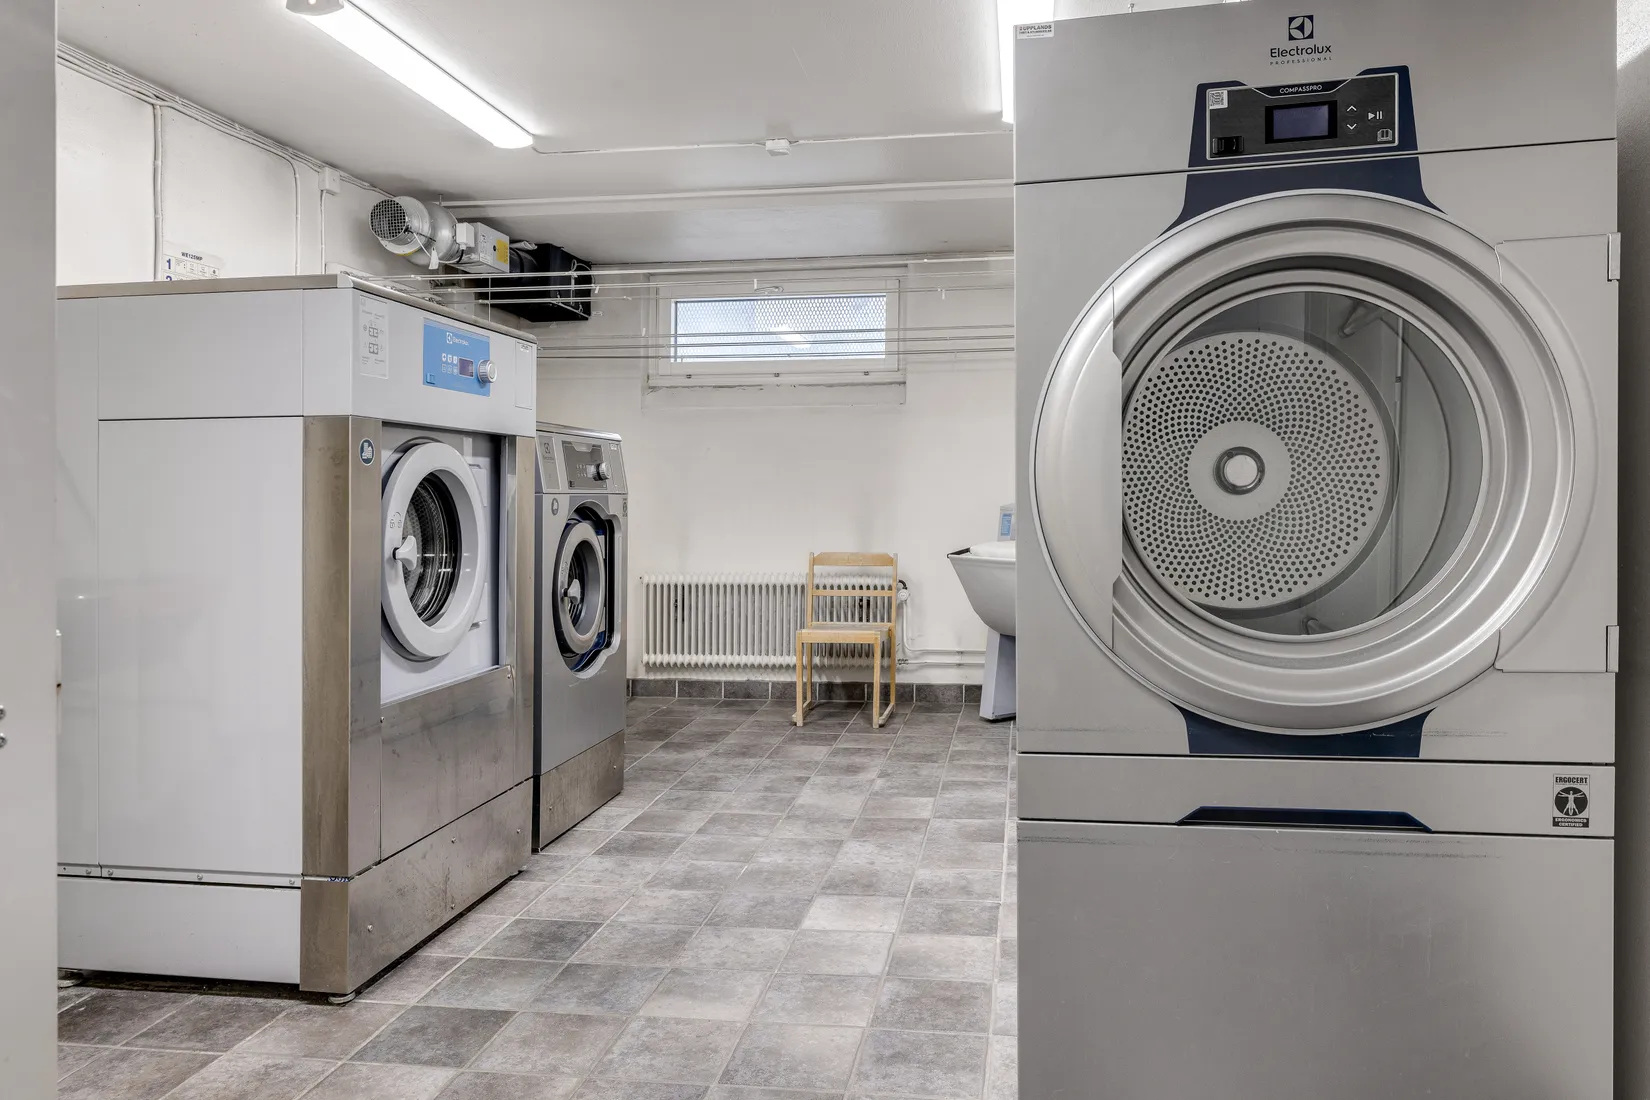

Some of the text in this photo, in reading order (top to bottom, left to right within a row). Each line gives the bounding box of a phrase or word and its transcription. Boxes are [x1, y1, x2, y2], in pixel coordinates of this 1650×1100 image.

[1270, 44, 1332, 58] Electrolux
[1269, 56, 1332, 66] PROFESSIONAL
[1279, 84, 1323, 94] COMPASSPRO
[166, 258, 171, 270] 1
[1555, 776, 1588, 784] ERGOCERT
